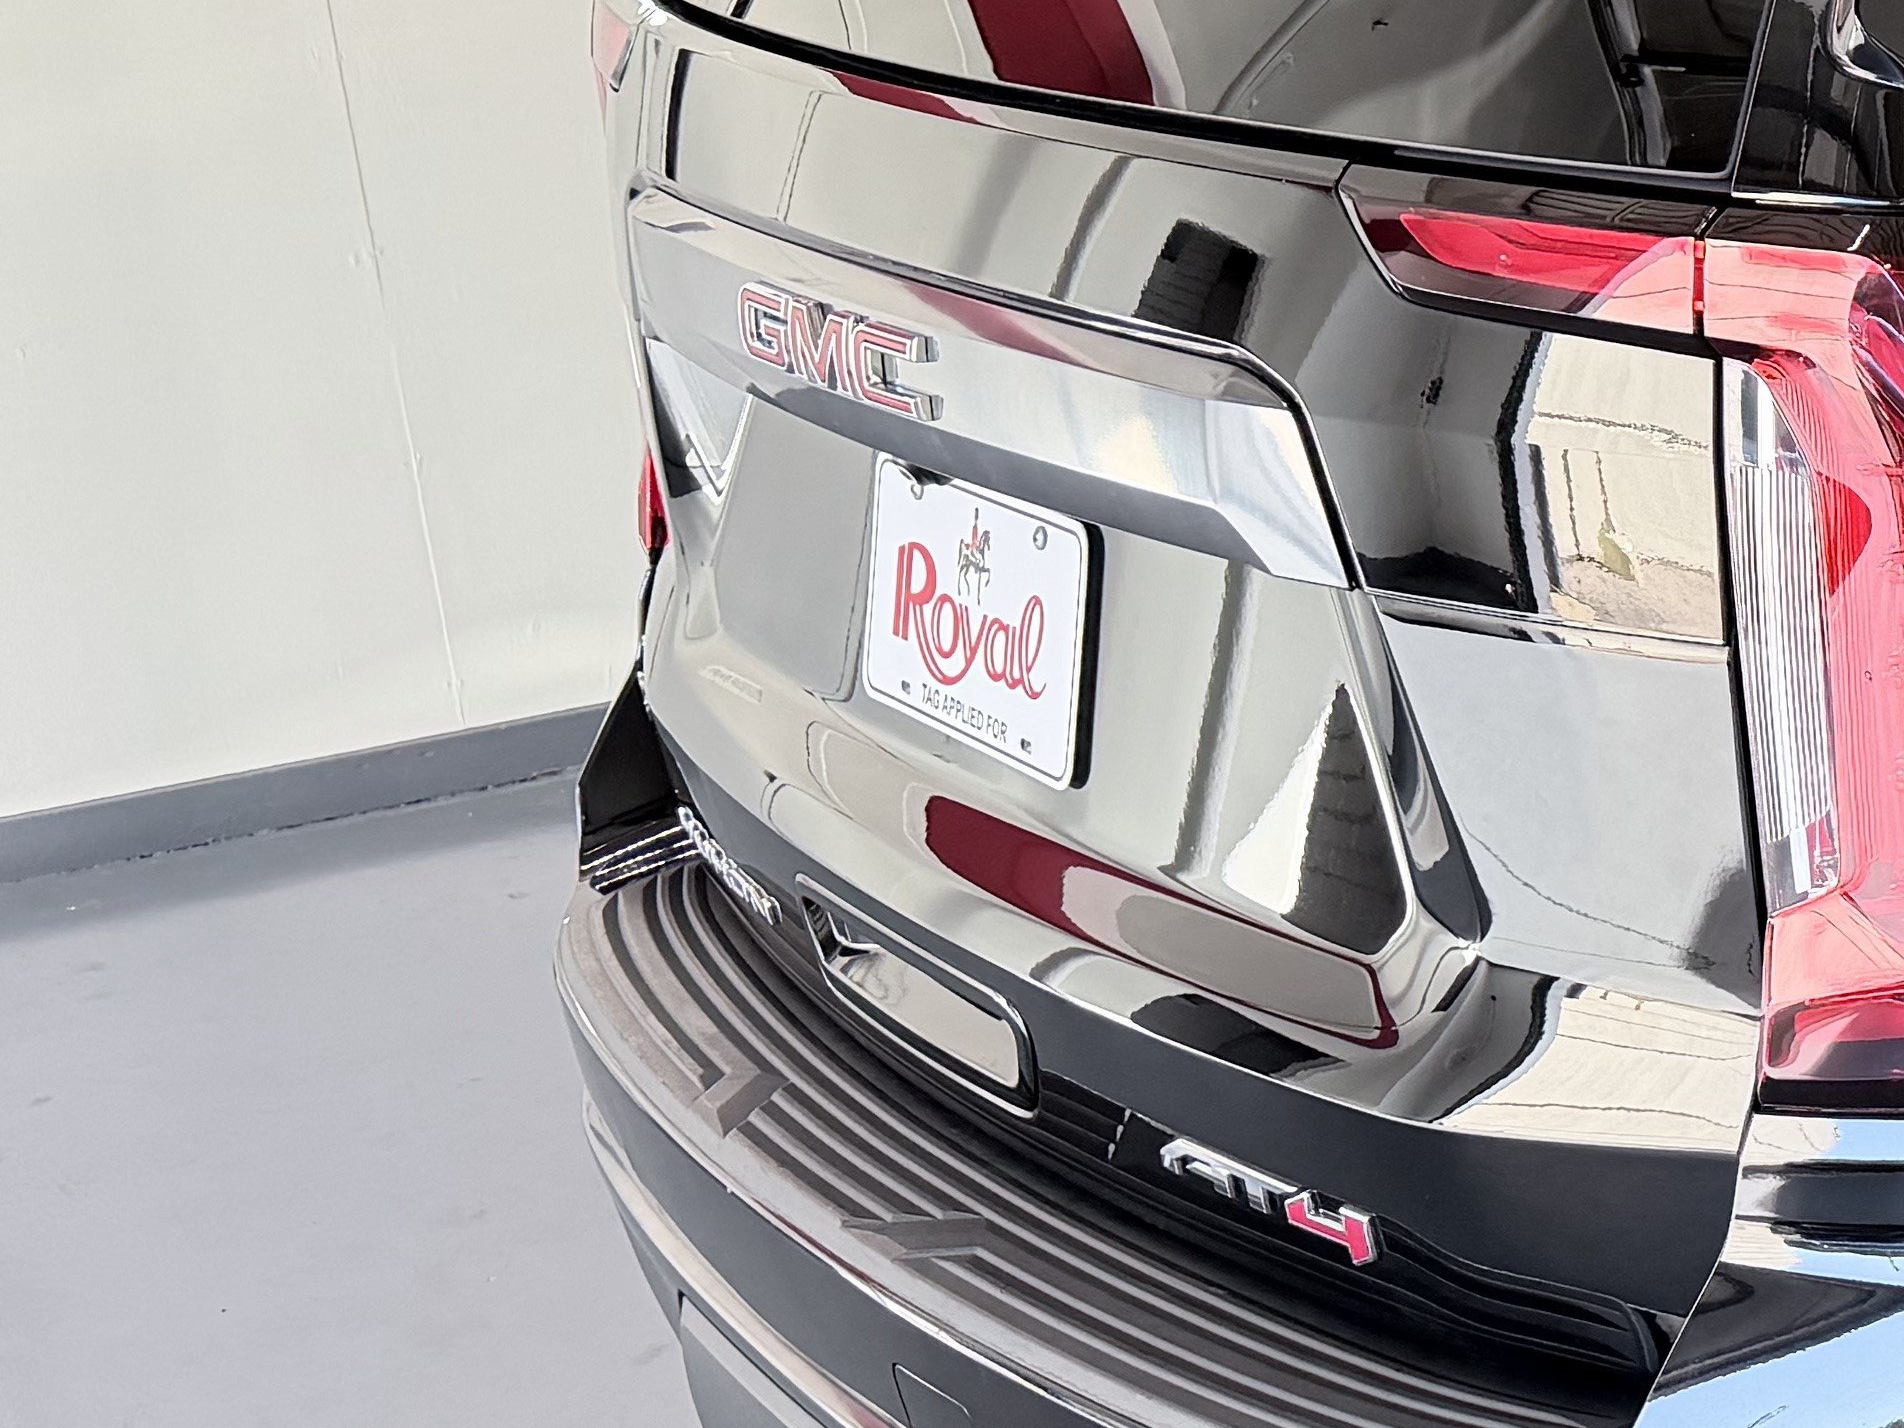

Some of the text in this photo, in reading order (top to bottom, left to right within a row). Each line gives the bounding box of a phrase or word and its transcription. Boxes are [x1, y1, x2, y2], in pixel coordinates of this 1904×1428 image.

[738, 281, 943, 422] GMC
[892, 542, 1047, 700] Royal
[920, 682, 1008, 744] TAG APPLIED FOR
